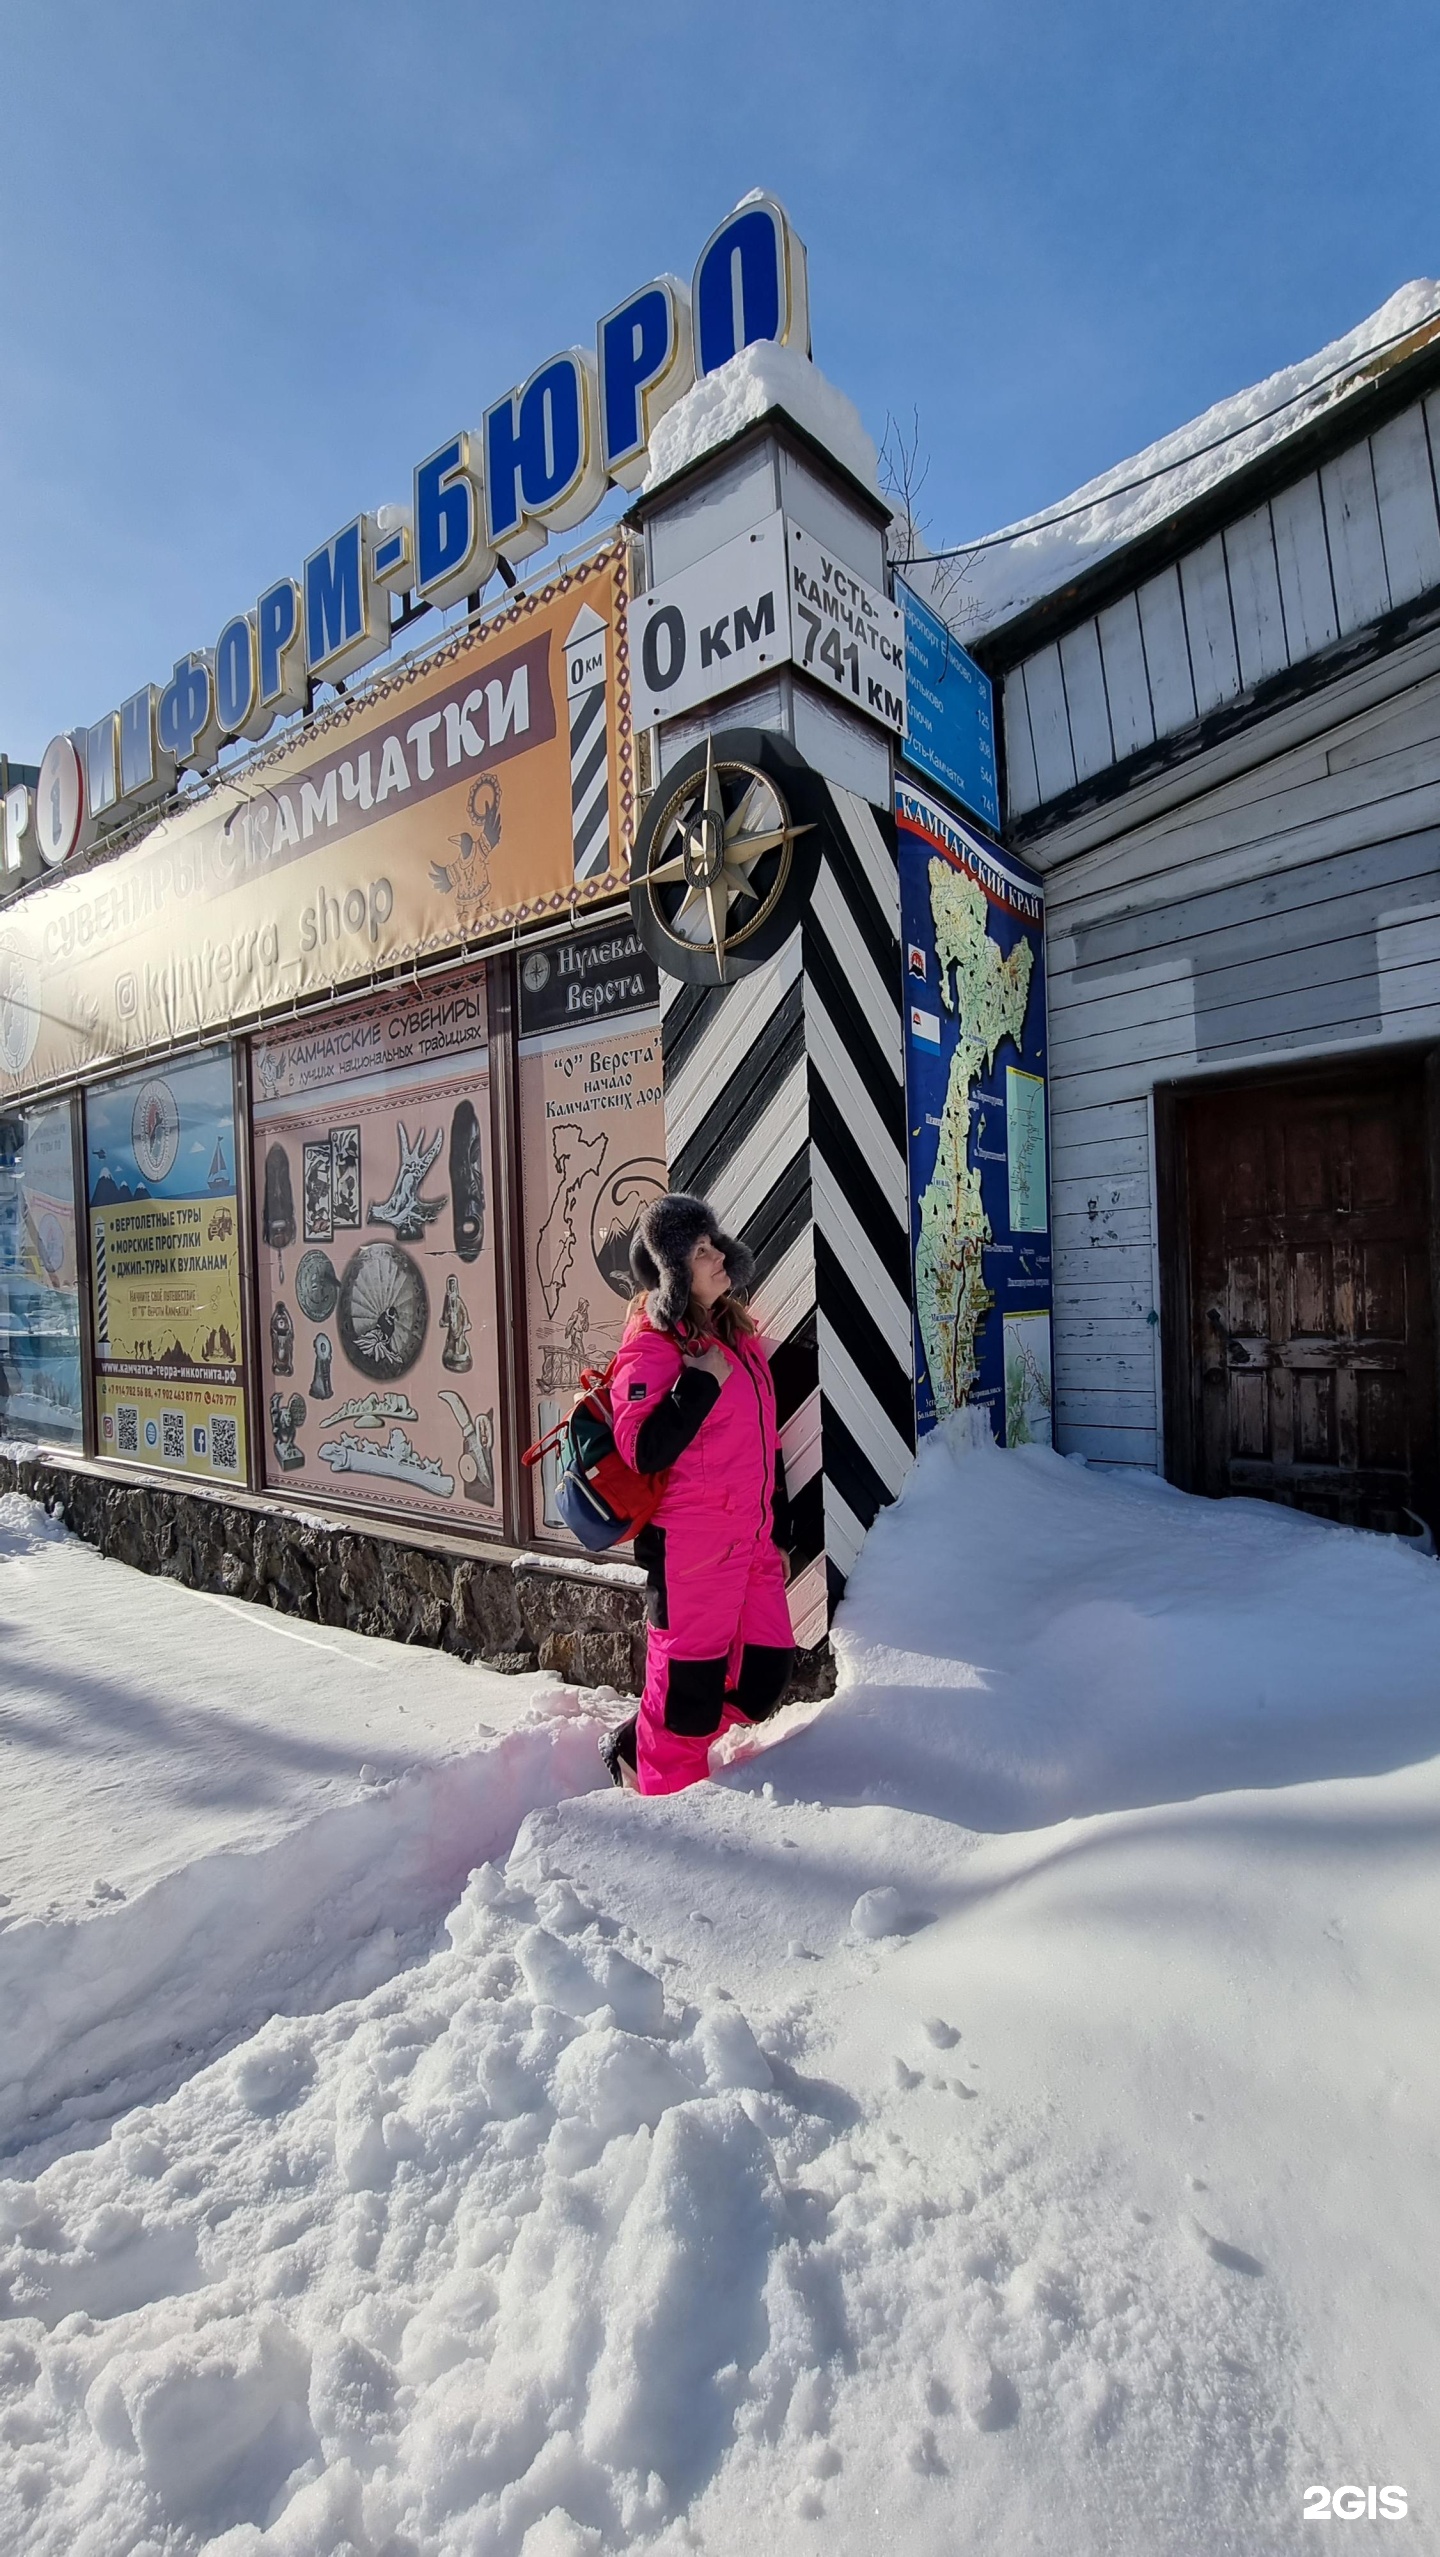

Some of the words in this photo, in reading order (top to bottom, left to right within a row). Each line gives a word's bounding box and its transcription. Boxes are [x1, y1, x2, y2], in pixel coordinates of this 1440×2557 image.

[86, 200, 797, 823] ИНФОРМ-БЮРО
[820, 556, 879, 620] УСТЬ-
[793, 565, 904, 671] КАМЧАТСК
[642, 605, 687, 693] 0
[797, 602, 860, 696] 741
[900, 599, 939, 649] Аэропорт
[977, 680, 987, 700] 38
[571, 658, 584, 685] 0
[977, 709, 990, 731] 125
[978, 737, 991, 759] 308
[980, 766, 993, 787] 544
[43, 841, 206, 964] СУВЕНИРЫ
[243, 664, 530, 869] КАМЧАТКИ
[982, 795, 994, 815] 741
[901, 793, 1006, 901] КАМЧАТСКИЙ
[1008, 884, 1040, 920] КРАЙ
[565, 975, 645, 1013] Верста
[287, 1022, 381, 1067] КАМЧАТСКИЕ
[388, 994, 481, 1040] СУВЕНИРЫ
[339, 1043, 413, 1073] национальных
[418, 1025, 482, 1054] традициях
[584, 1073, 632, 1094] начало
[546, 1092, 633, 1118] Камчатских
[115, 1212, 175, 1232] ВЕРТОЛЕТНЫЕ
[176, 1208, 202, 1224] ТУРЫ
[116, 1237, 153, 1254] МОРСКИЕ
[155, 1232, 201, 1251] ПРОГУЛКИ
[117, 1258, 168, 1279] ДЖИП-ТУРЫ
[169, 1259, 176, 1273] К
[178, 1254, 228, 1272] ВУЛКАНАМ
[101, 1362, 237, 1384] www.камчатка-терра-инкогнита.рф
